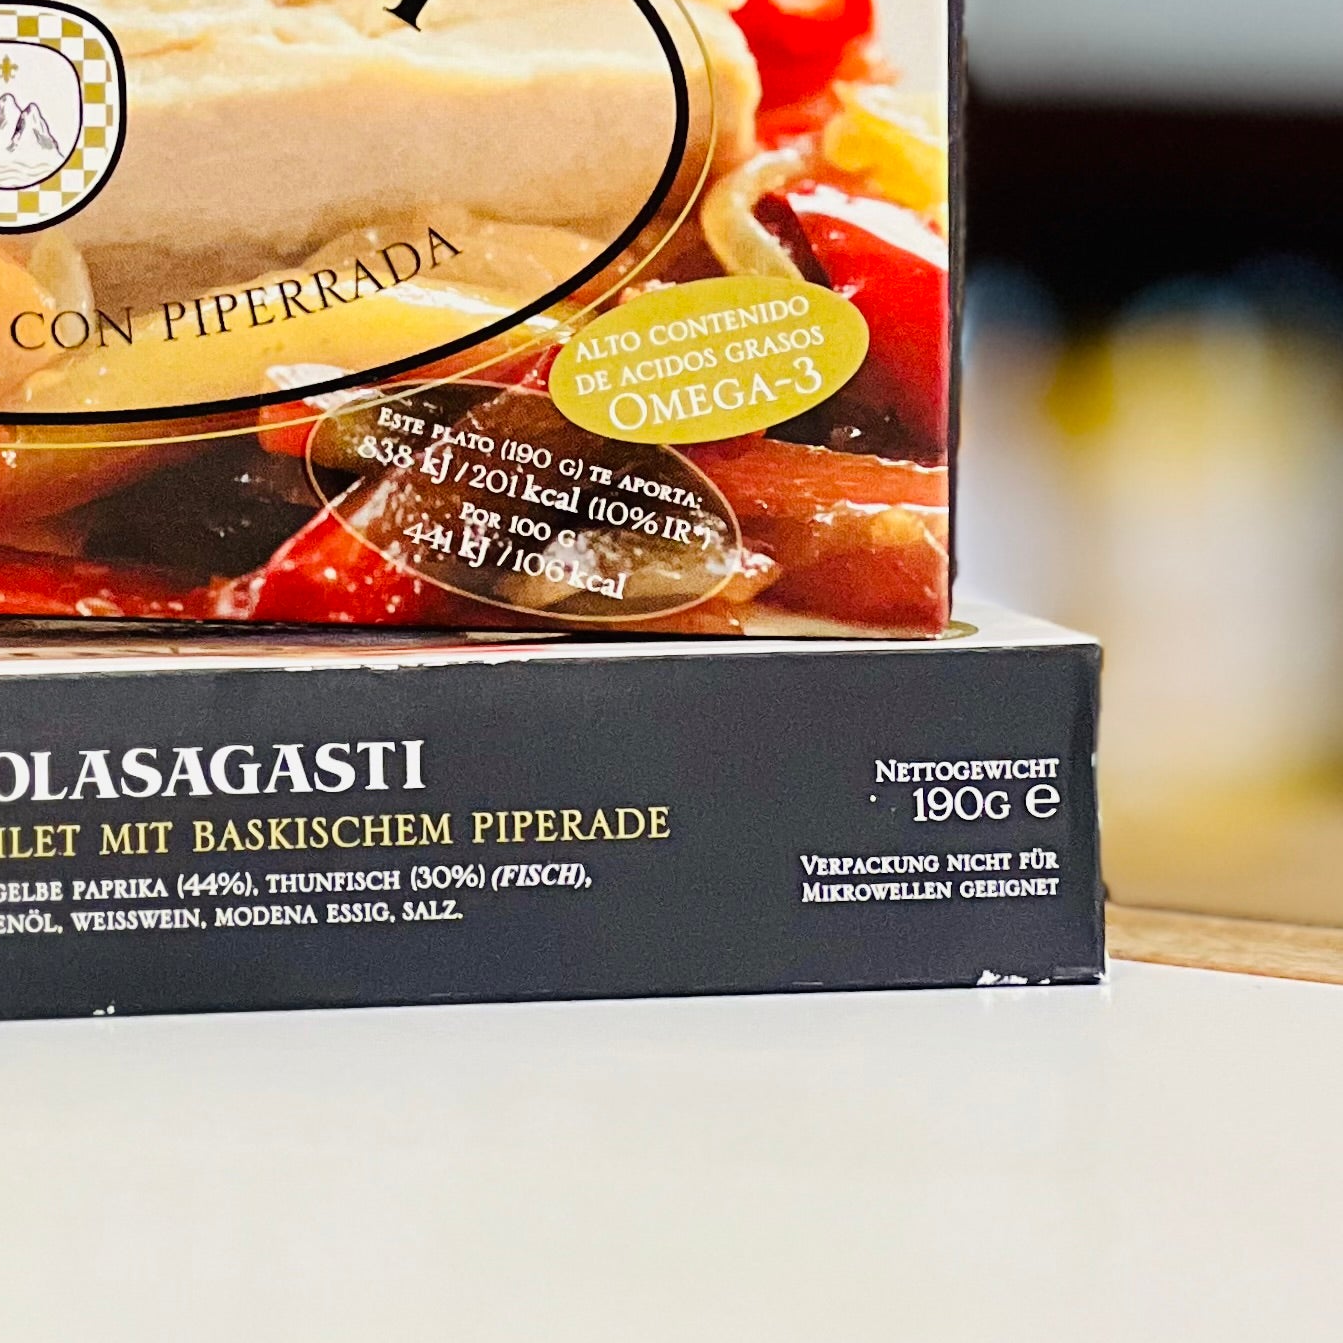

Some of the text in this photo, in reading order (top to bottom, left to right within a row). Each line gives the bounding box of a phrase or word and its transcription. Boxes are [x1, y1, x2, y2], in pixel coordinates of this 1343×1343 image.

[9, 306, 134, 350] CON
[158, 226, 464, 342] PIPERRADA
[575, 295, 810, 363] ALTO CONTENIDO
[575, 325, 825, 396] DE ACIDOS GRASOS
[608, 356, 823, 431] OMEGA-3
[378, 406, 703, 510] ESTE PLATO (190 G) TE APORTA:
[357, 435, 415, 469] 838
[420, 446, 454, 485] kJ
[520, 473, 581, 514] kcal
[588, 496, 658, 535] (10%
[458, 501, 577, 548] POR 100 G
[403, 522, 453, 554] 441
[458, 526, 491, 568] kJ
[567, 560, 627, 600] kcal
[875, 758, 1060, 783] NETTOGEWICHT
[912, 785, 1011, 822] 190G
[99, 820, 173, 856] MIT
[191, 812, 453, 853] BASKISCHEM
[471, 805, 671, 844] PIPERADE
[72, 875, 169, 901] PAPRIKA
[265, 869, 400, 894] THUNFISCH
[410, 863, 485, 892] (30%)
[491, 863, 592, 892] (FISCH),
[799, 848, 1060, 876] VERPACKUNG NICHT FÜR
[801, 878, 1060, 903] MIKROWELLEN GEEIGNET
[70, 908, 207, 933] WEISSWEIN,
[214, 904, 318, 927] MODENA
[326, 901, 396, 924] ESSIG,
[402, 900, 464, 922] SALZ.
